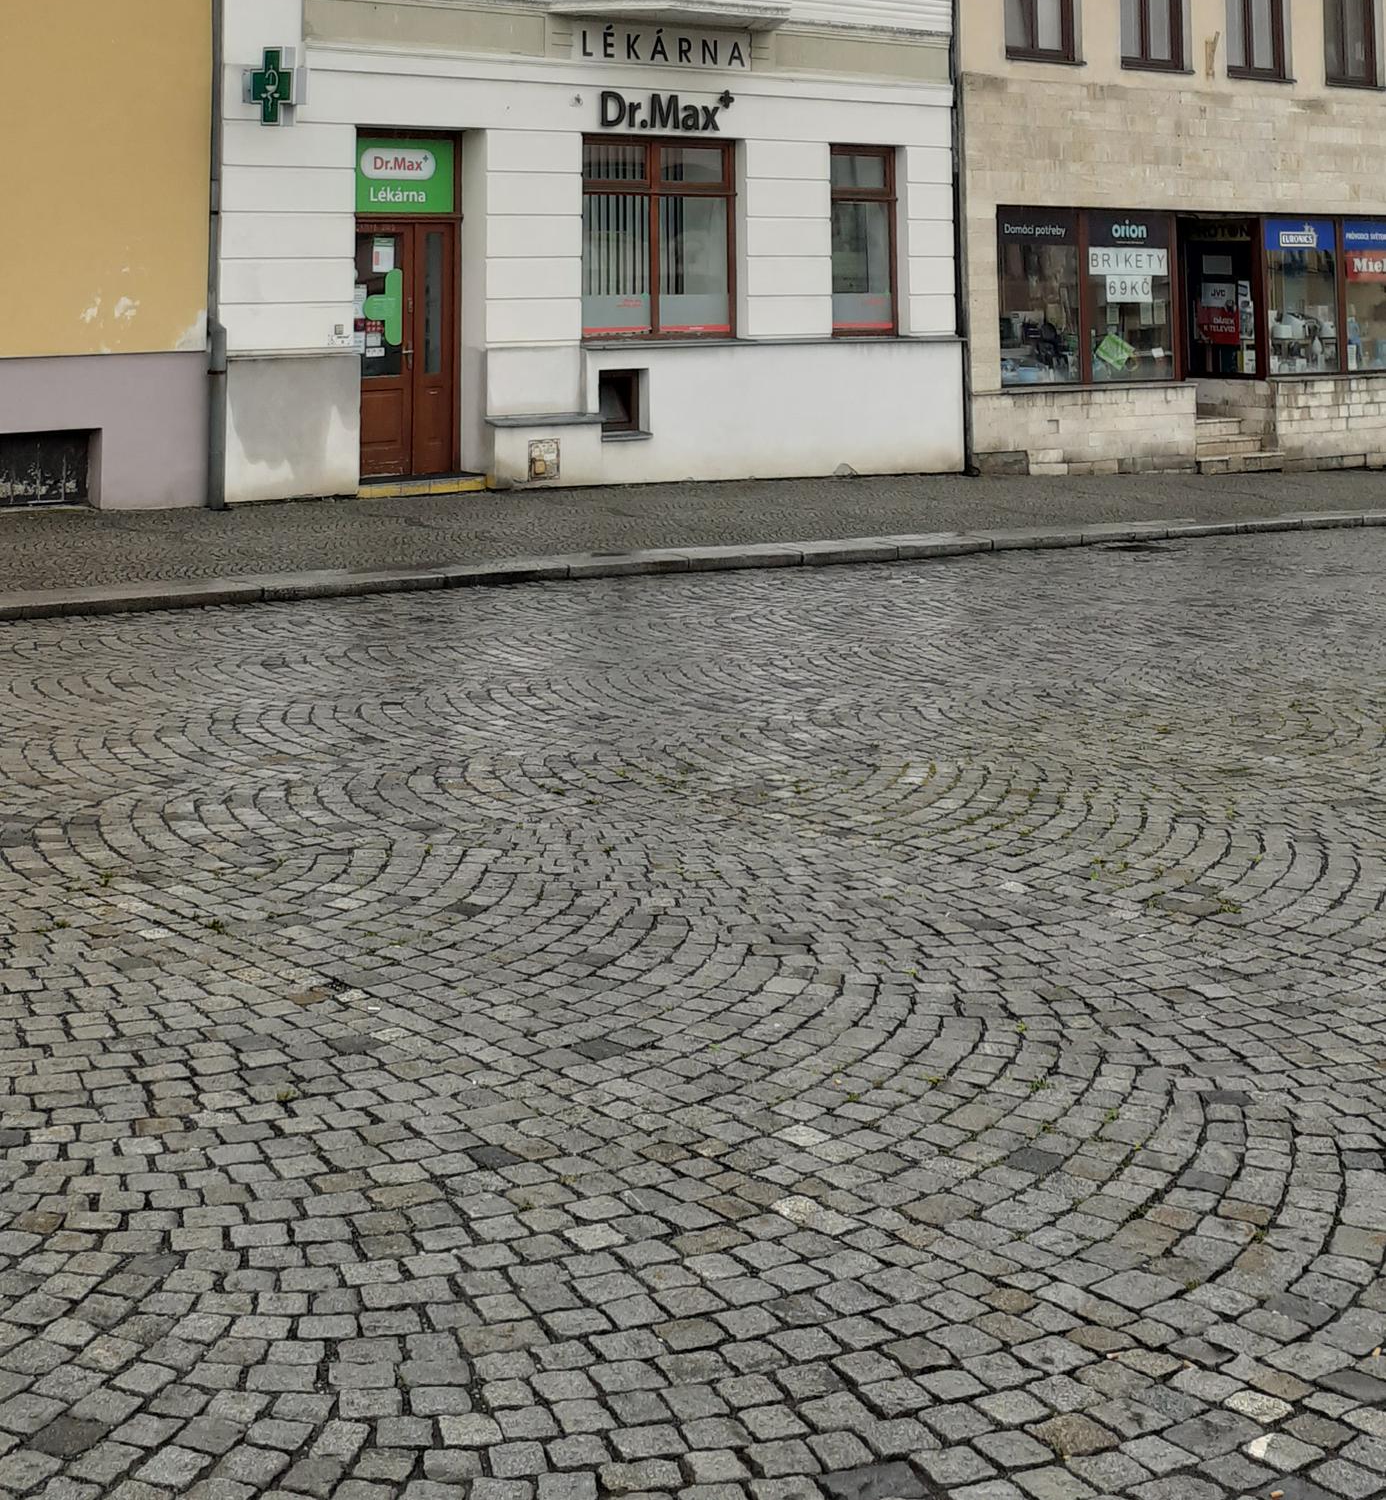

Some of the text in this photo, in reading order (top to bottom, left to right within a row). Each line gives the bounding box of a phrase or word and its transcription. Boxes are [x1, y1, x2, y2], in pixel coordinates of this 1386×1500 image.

[581, 24, 746, 68] LÉKÁRNA
[369, 185, 426, 203] Lékárna
[1003, 223, 1066, 238] Domácí potřeby
[1111, 219, 1147, 238] orion
[1282, 234, 1313, 244] EURONICS
[1090, 253, 1165, 269] BRIKETY
[1211, 288, 1226, 297] JVC
